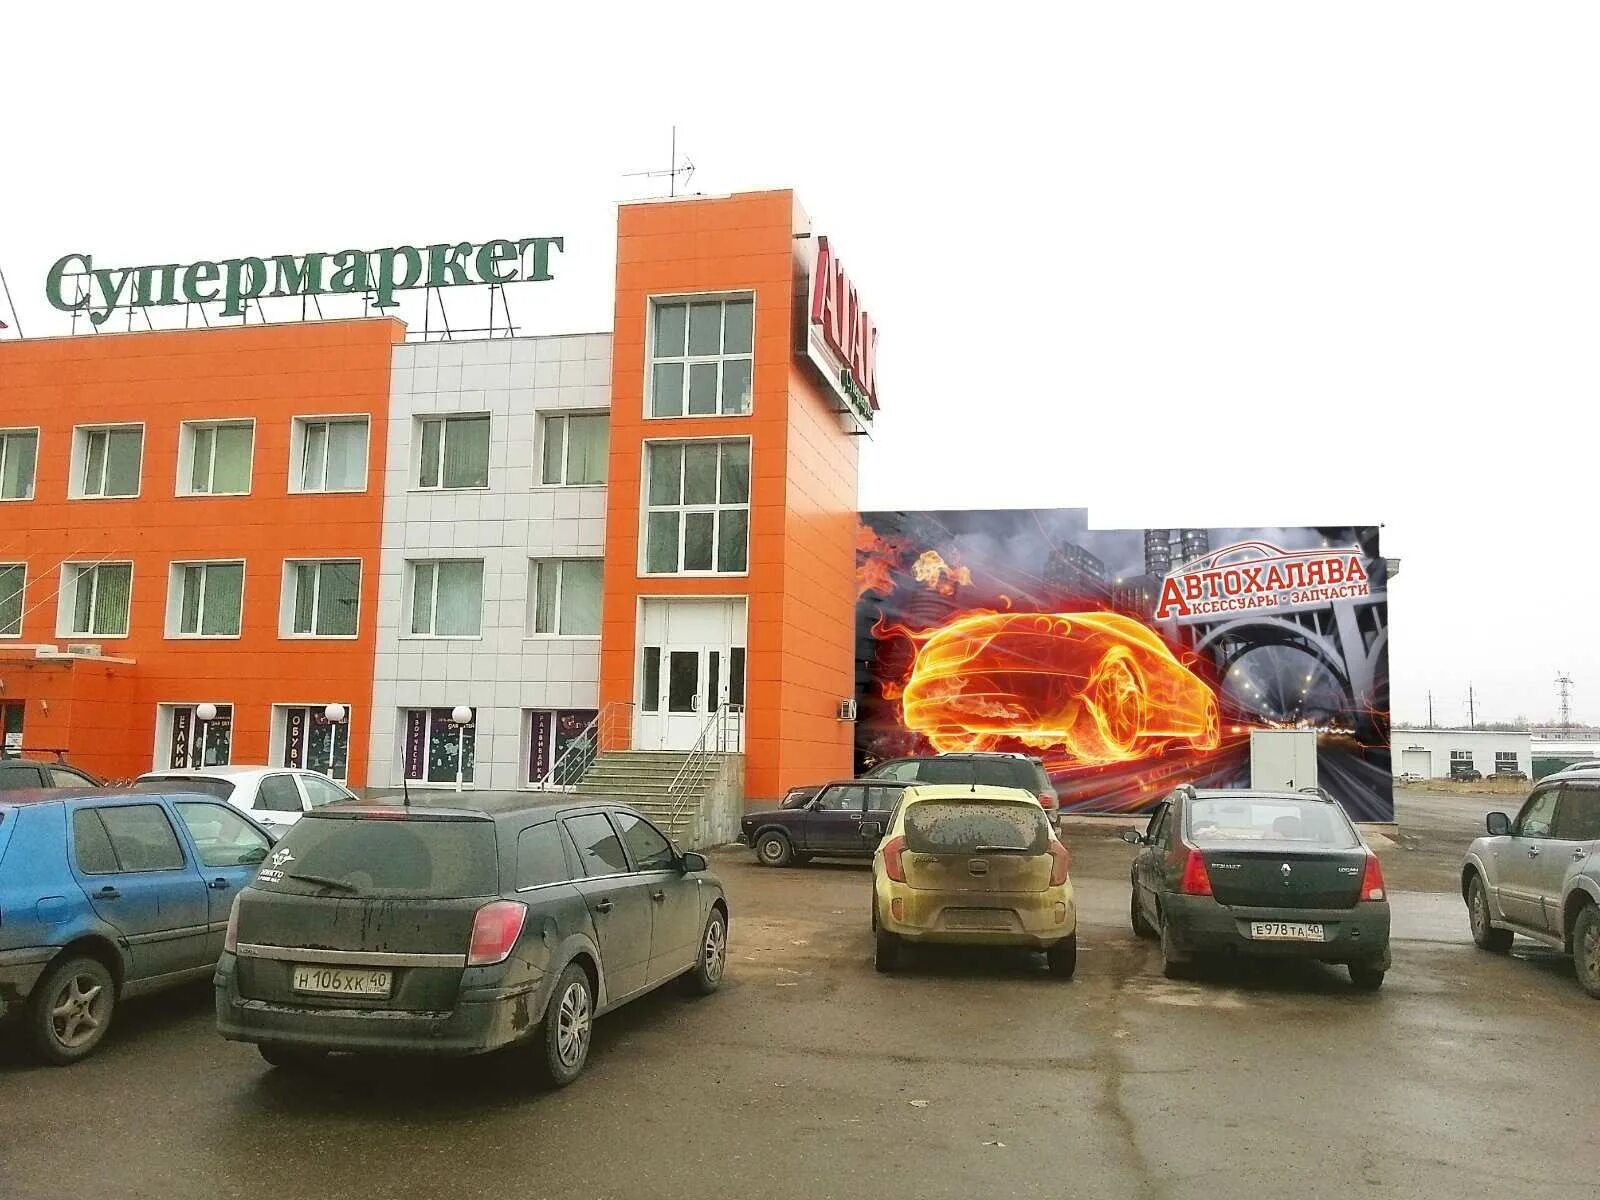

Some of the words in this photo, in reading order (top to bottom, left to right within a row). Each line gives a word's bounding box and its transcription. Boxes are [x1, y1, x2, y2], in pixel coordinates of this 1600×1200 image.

[46, 236, 564, 323] Супермаркет
[1157, 556, 1367, 618] АВТОХАЛЯВА
[1291, 584, 1368, 605] ЗАПЧАСТИ
[290, 715, 301, 769] ОБУВЬ
